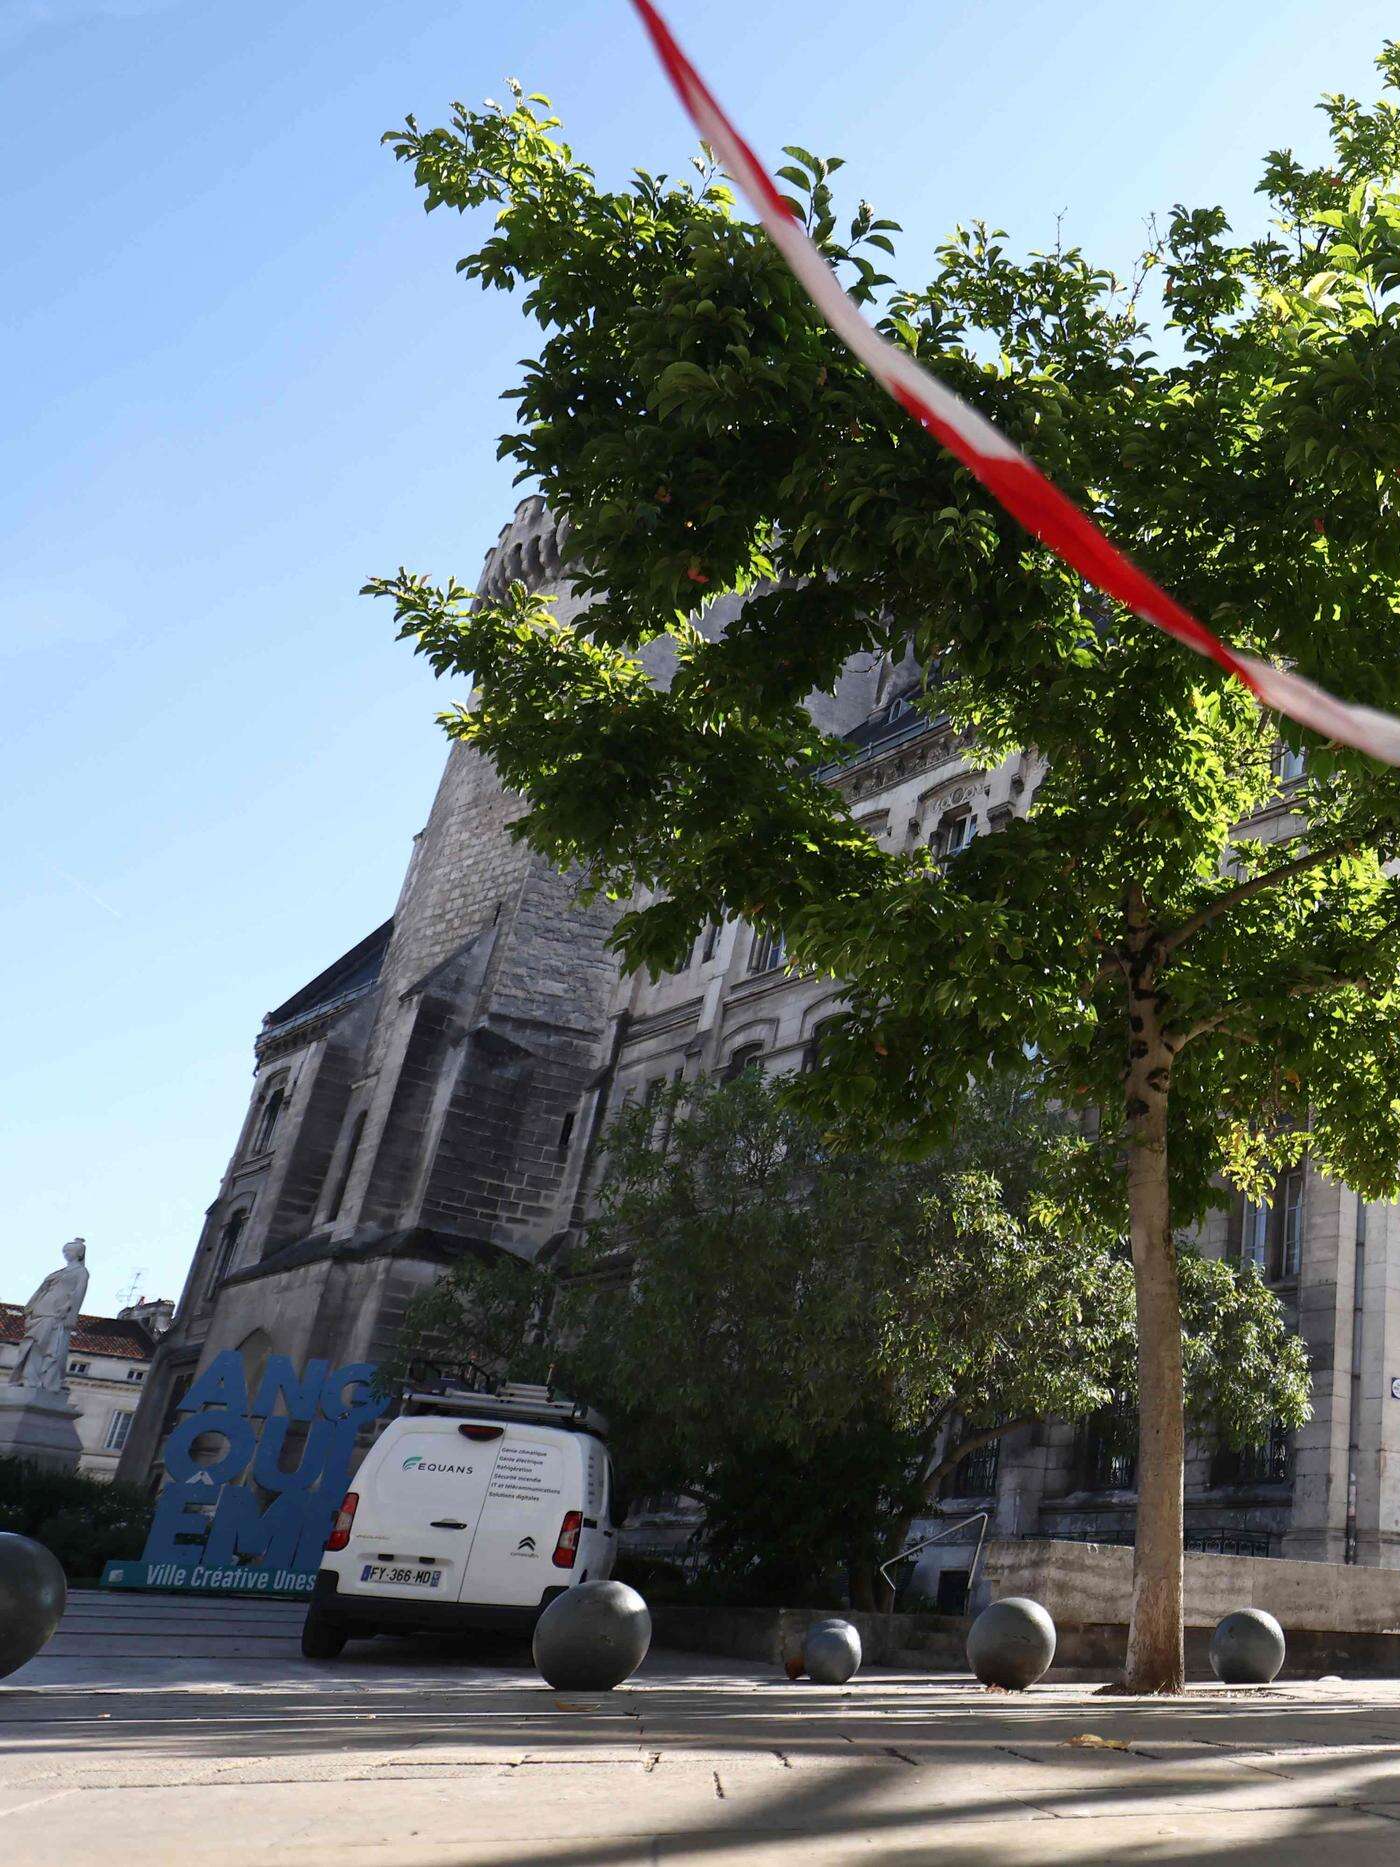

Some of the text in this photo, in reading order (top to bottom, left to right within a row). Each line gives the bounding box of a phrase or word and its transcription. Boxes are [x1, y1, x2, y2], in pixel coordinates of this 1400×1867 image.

[418, 1463, 473, 1475] EQUANS
[146, 1564, 317, 1592] Ville Créative Unes
